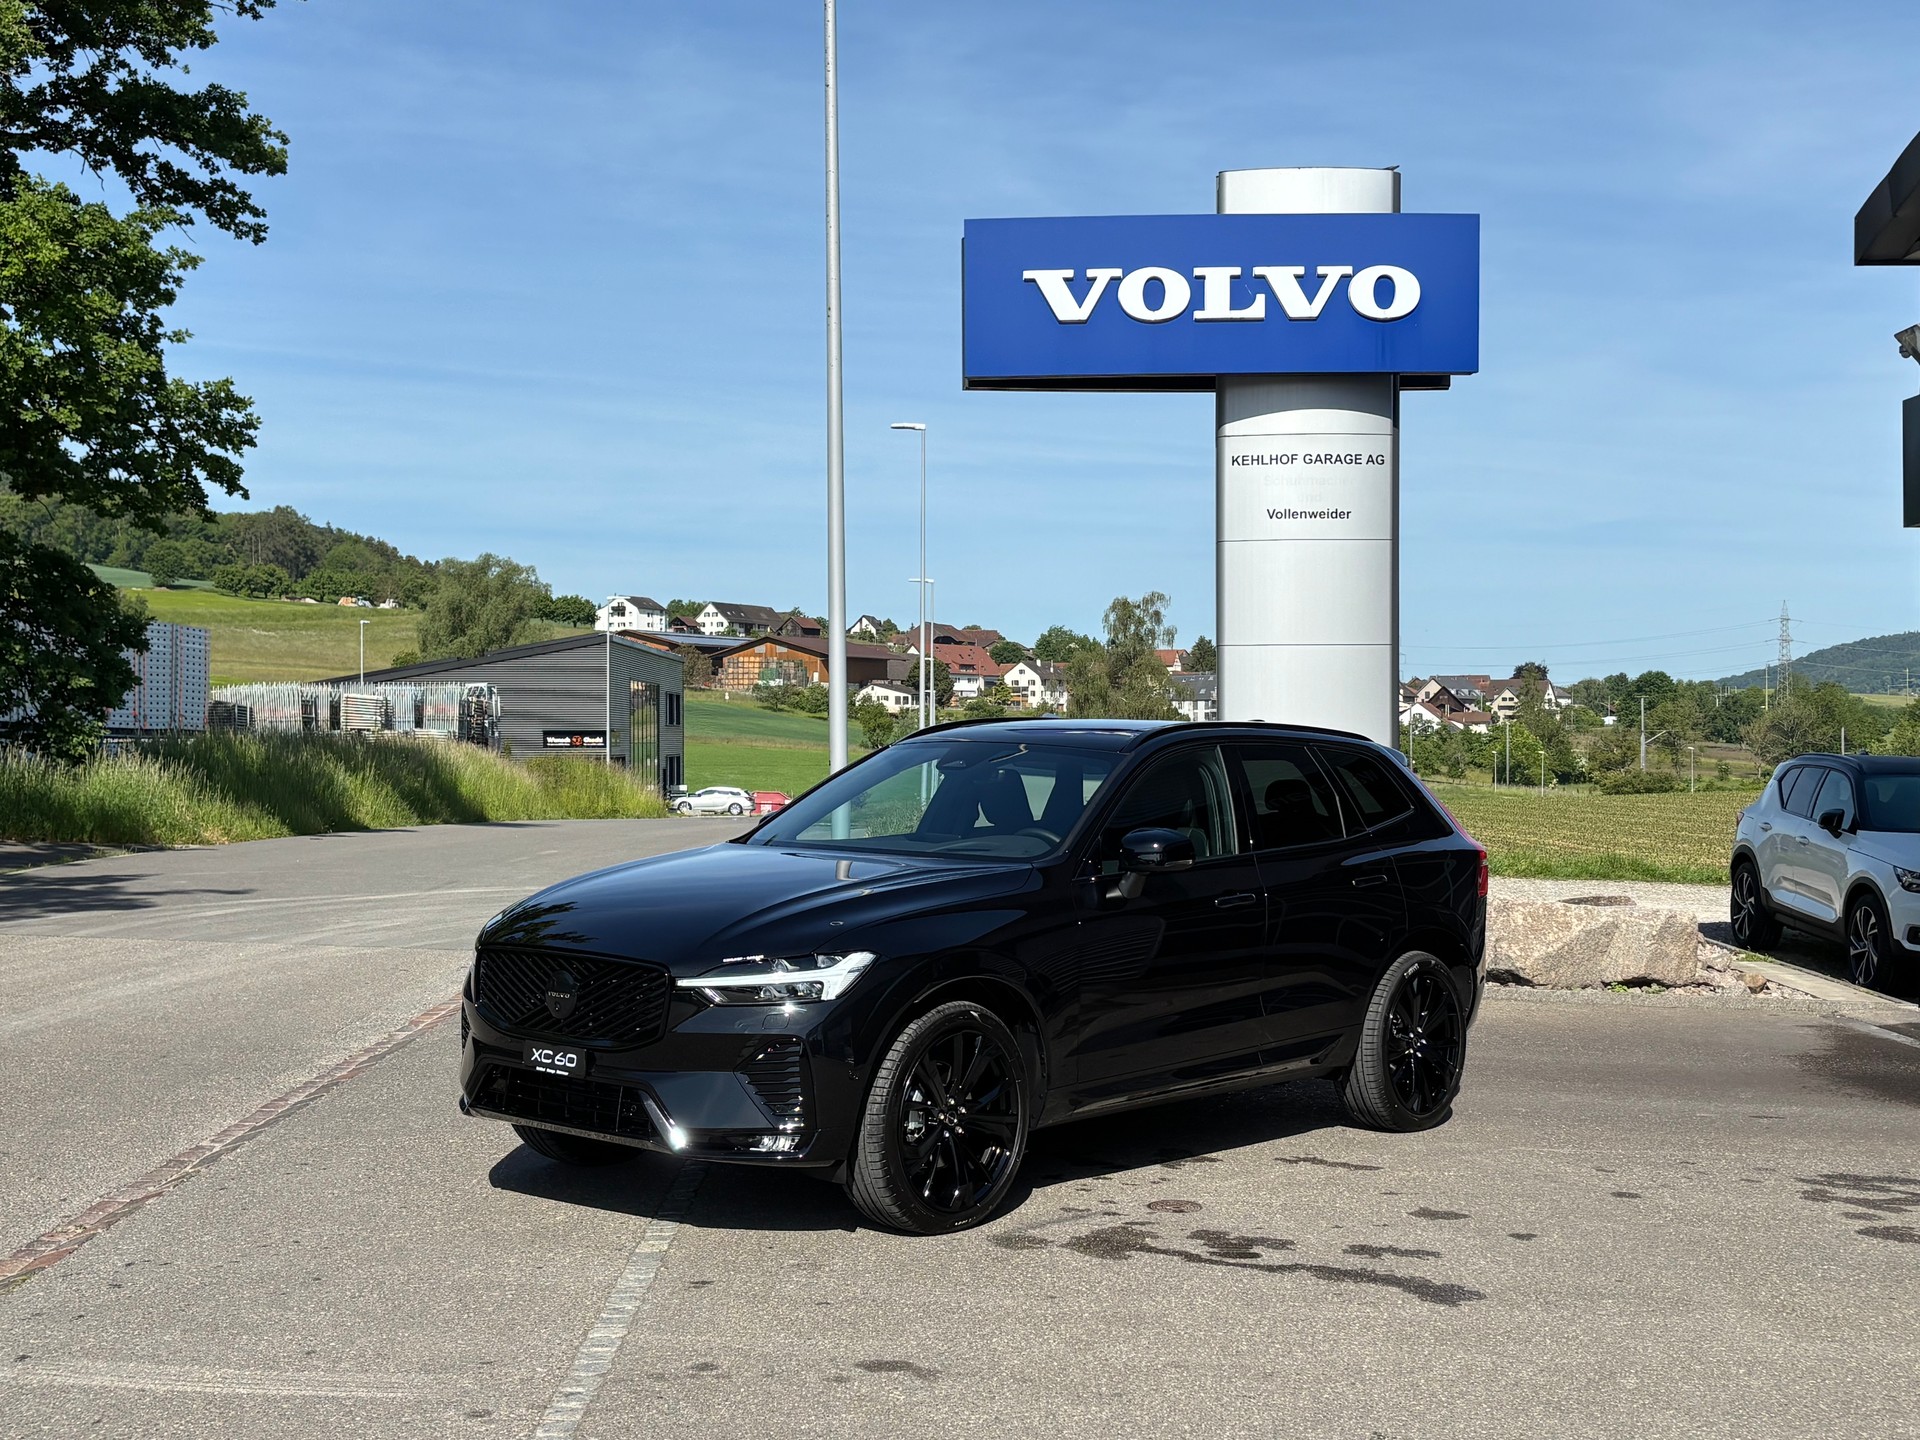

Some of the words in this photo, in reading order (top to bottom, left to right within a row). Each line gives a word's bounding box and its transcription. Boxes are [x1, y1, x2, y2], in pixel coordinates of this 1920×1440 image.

[1023, 265, 1421, 324] VOLVO
[1231, 454, 1298, 466] KEHLHOF
[1303, 453, 1362, 465] GARAGE
[1366, 454, 1385, 465] AG
[1266, 508, 1352, 519] Vollenweider
[547, 991, 570, 999] VOLVO
[531, 1047, 577, 1068] XC60
